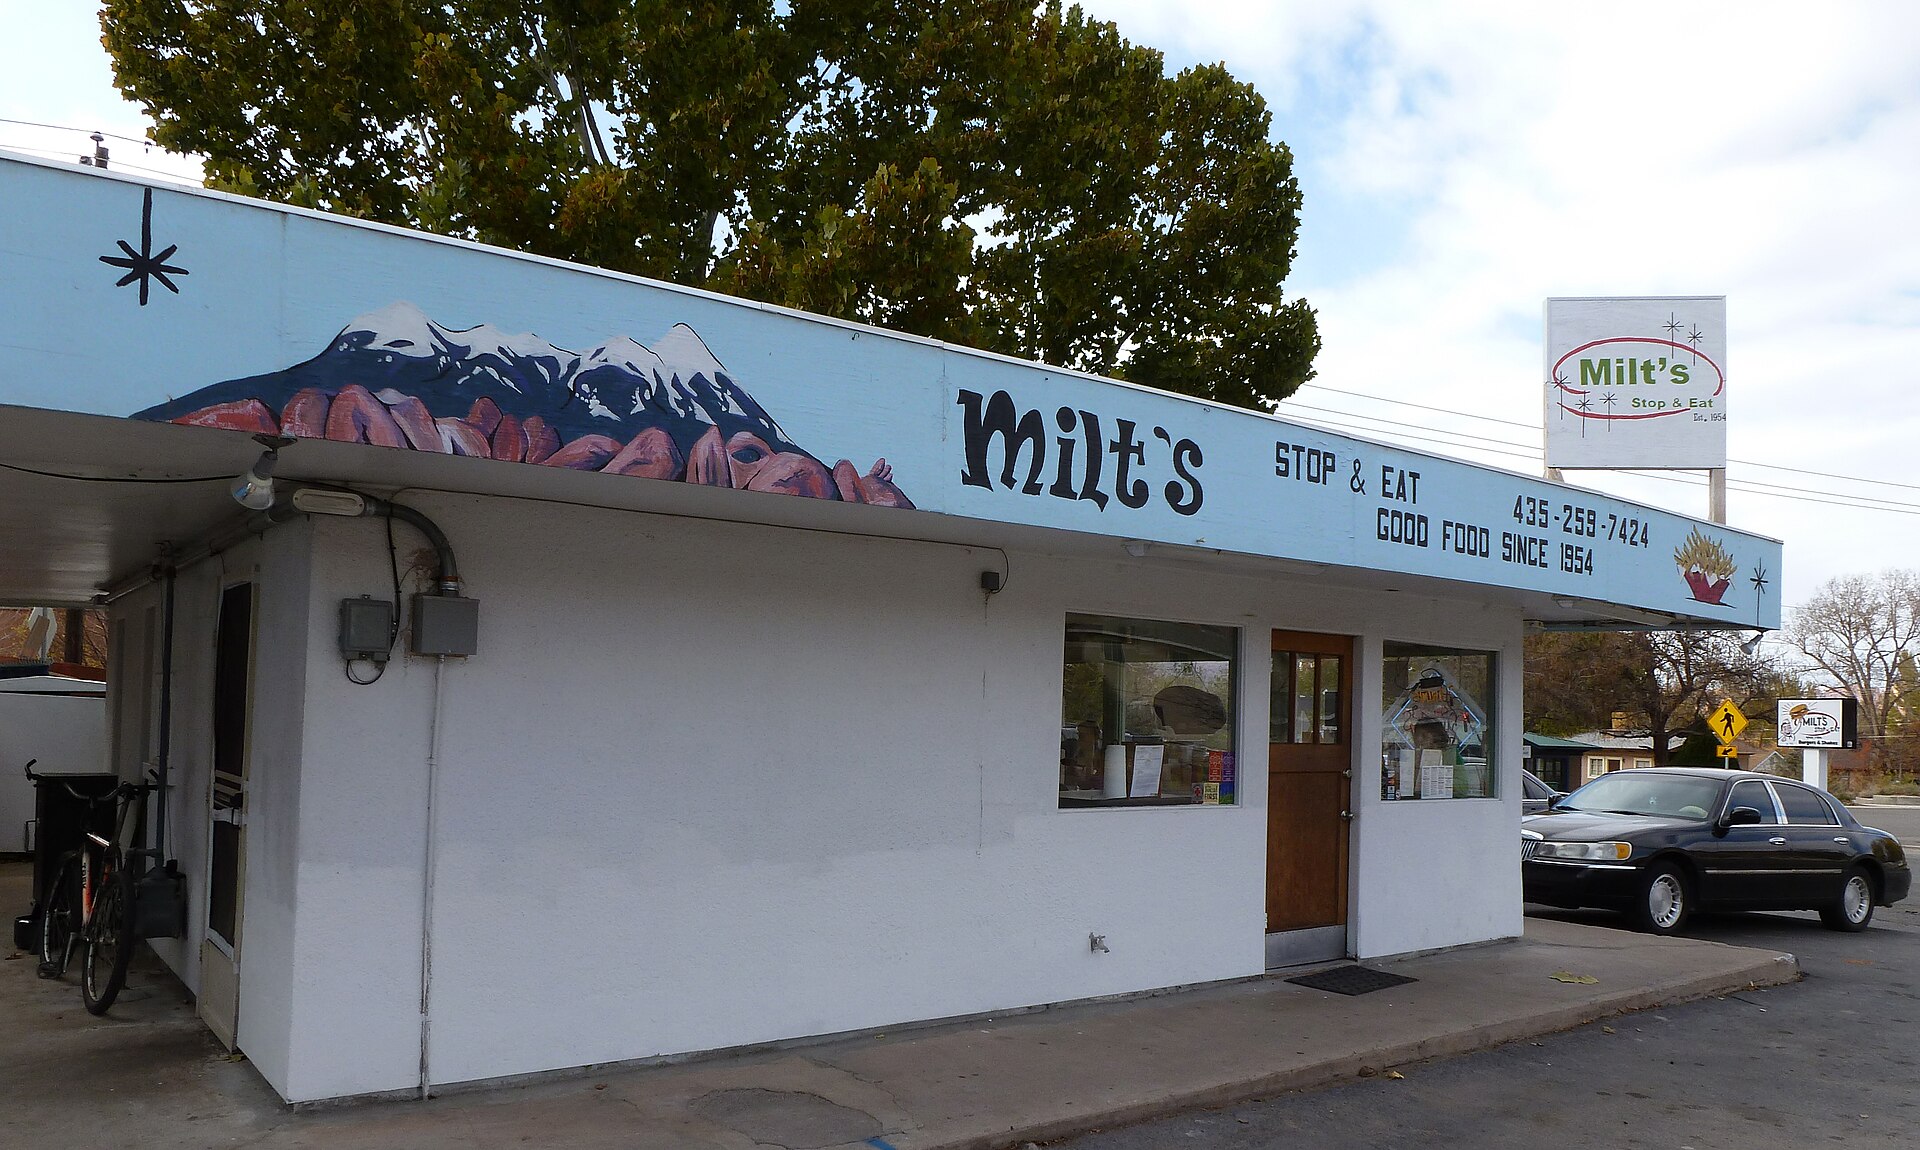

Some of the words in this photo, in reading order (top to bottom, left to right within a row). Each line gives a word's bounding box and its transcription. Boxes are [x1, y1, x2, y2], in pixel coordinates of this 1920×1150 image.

[1579, 357, 1691, 386] Milt's
[1631, 397, 1666, 410] Stop
[1672, 398, 1682, 408] &
[1689, 398, 1714, 408] Eat
[1693, 412, 1707, 422] Est.
[1710, 412, 1727, 422] 1954
[1275, 440, 1336, 486] STOP
[1349, 458, 1366, 496] &
[1381, 464, 1421, 505] EAT
[1376, 507, 1429, 548] GOOD
[1442, 519, 1490, 559] FOOD
[1501, 531, 1549, 569] SINCE
[1560, 541, 1594, 576] 1954
[1512, 494, 1649, 549] 435-259-7424
